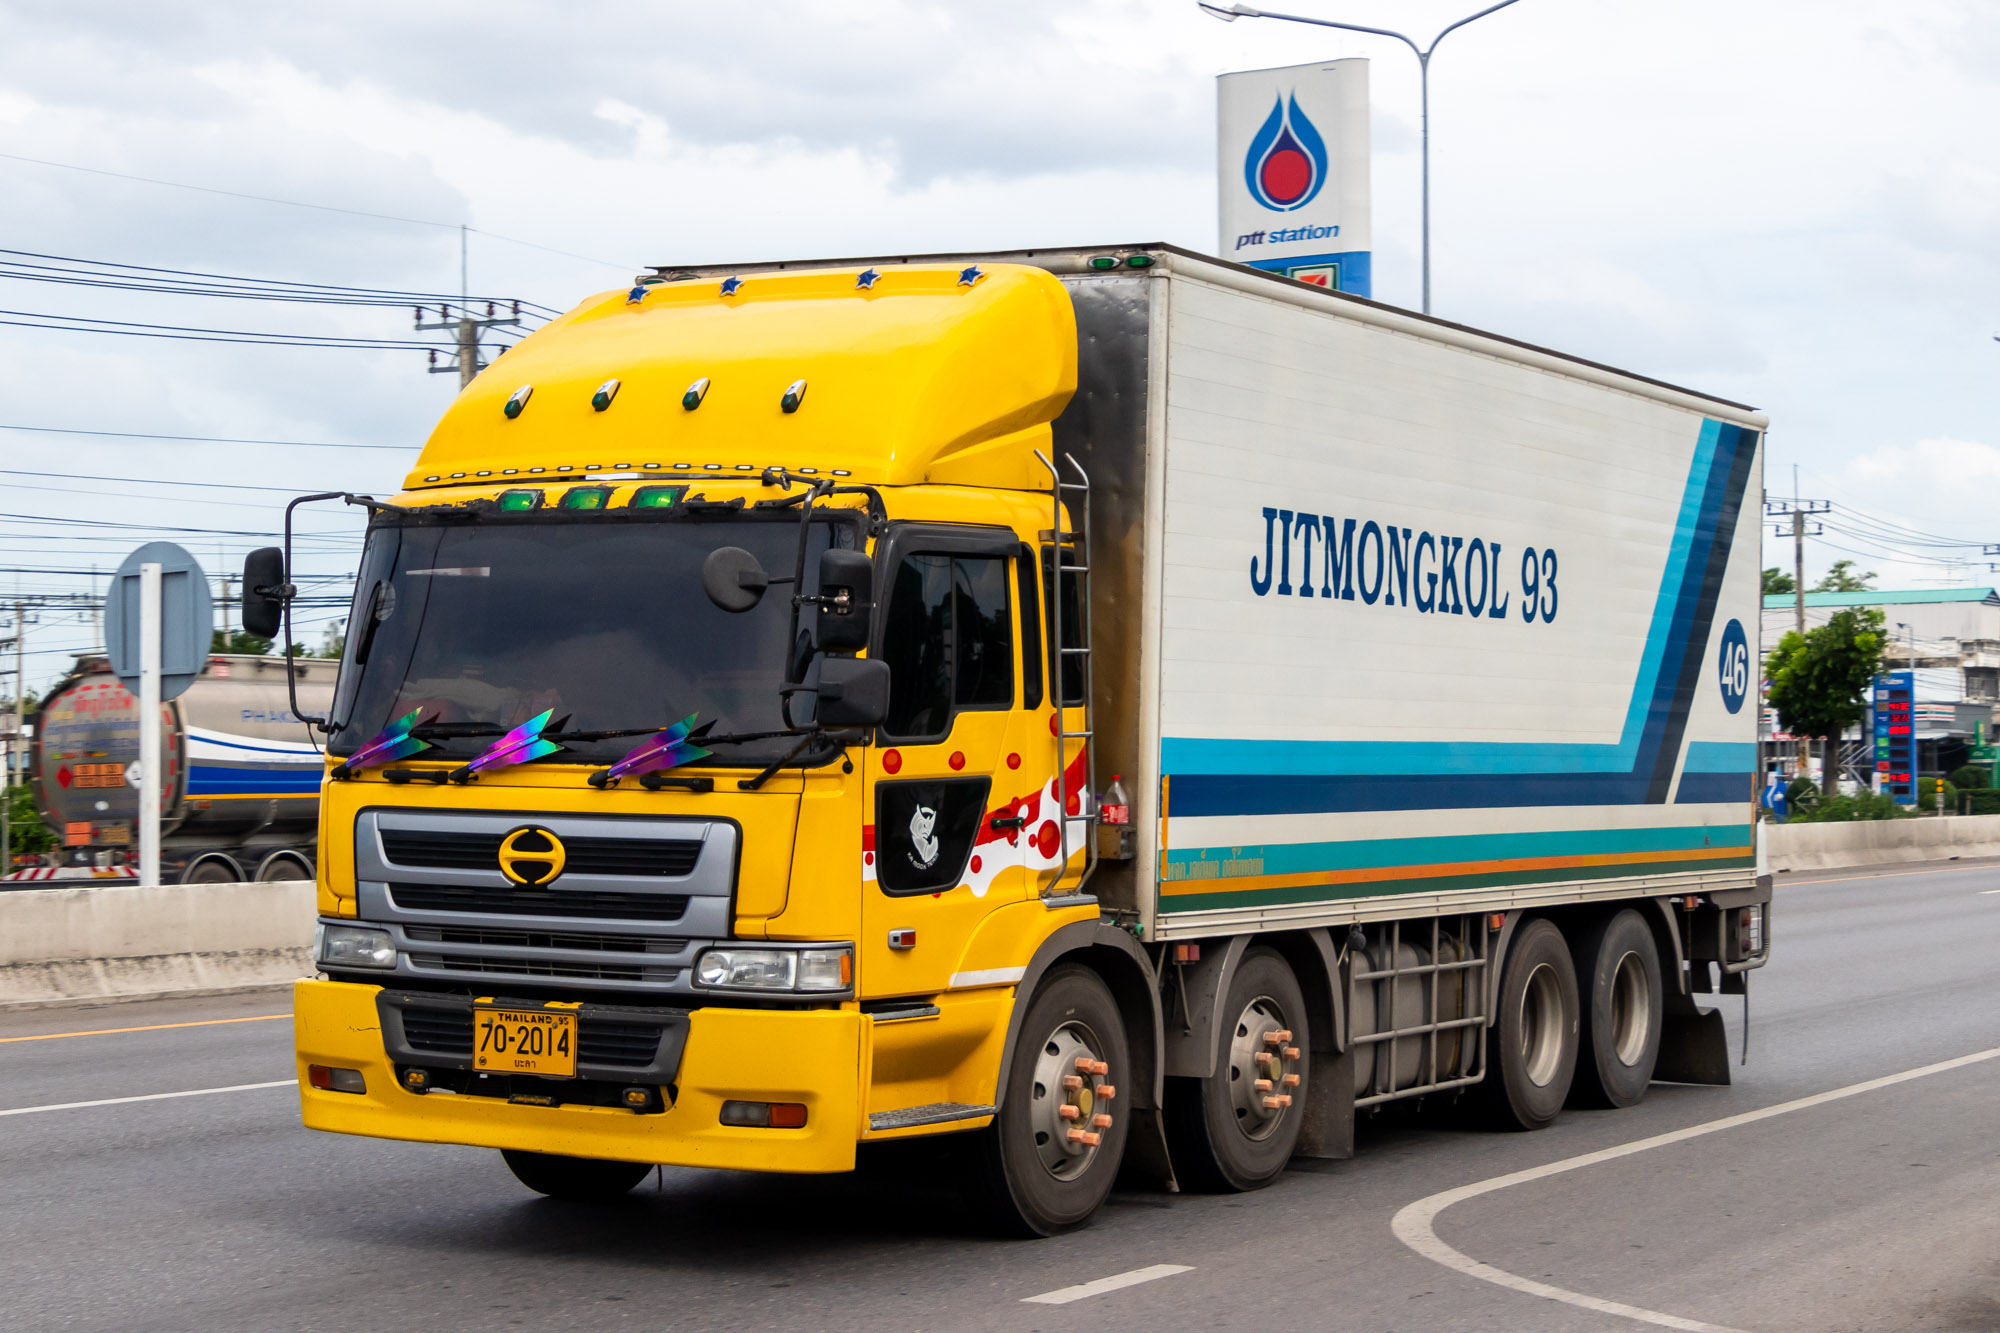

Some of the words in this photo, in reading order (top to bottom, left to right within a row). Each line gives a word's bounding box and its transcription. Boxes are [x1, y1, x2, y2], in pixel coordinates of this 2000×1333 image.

[1235, 230, 1266, 251] ptt
[1268, 224, 1340, 244] station
[1250, 506, 1509, 619] JITMONGKOL
[1521, 546, 1558, 624] 93
[1721, 641, 1746, 696] 46
[498, 1013, 552, 1023] THAILAND
[558, 1017, 568, 1025] 95
[480, 1023, 569, 1057] 70-2014
